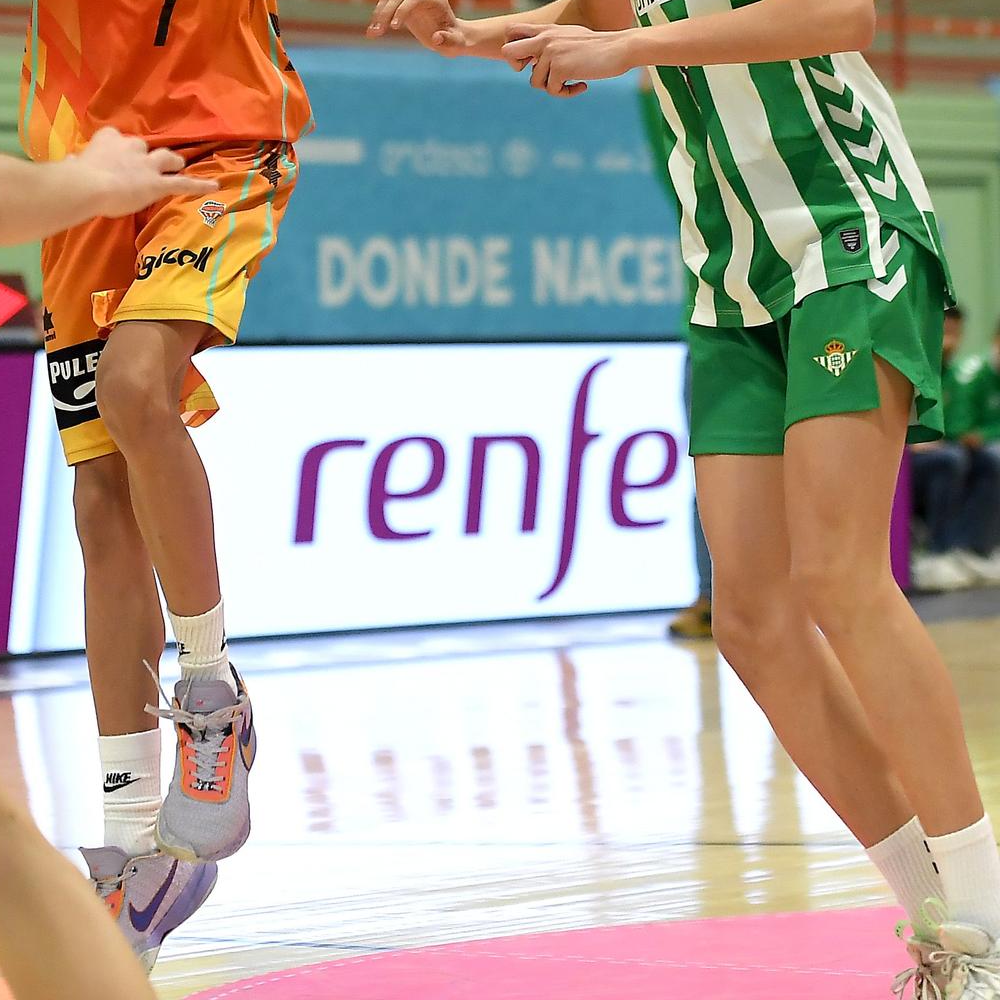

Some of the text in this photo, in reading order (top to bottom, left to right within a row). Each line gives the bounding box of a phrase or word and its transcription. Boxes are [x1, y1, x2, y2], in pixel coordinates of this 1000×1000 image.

[136, 246, 214, 280] gicoll
[318, 235, 513, 308] DONDE
[49, 351, 103, 384] PULE
[294, 358, 679, 601] renfe
